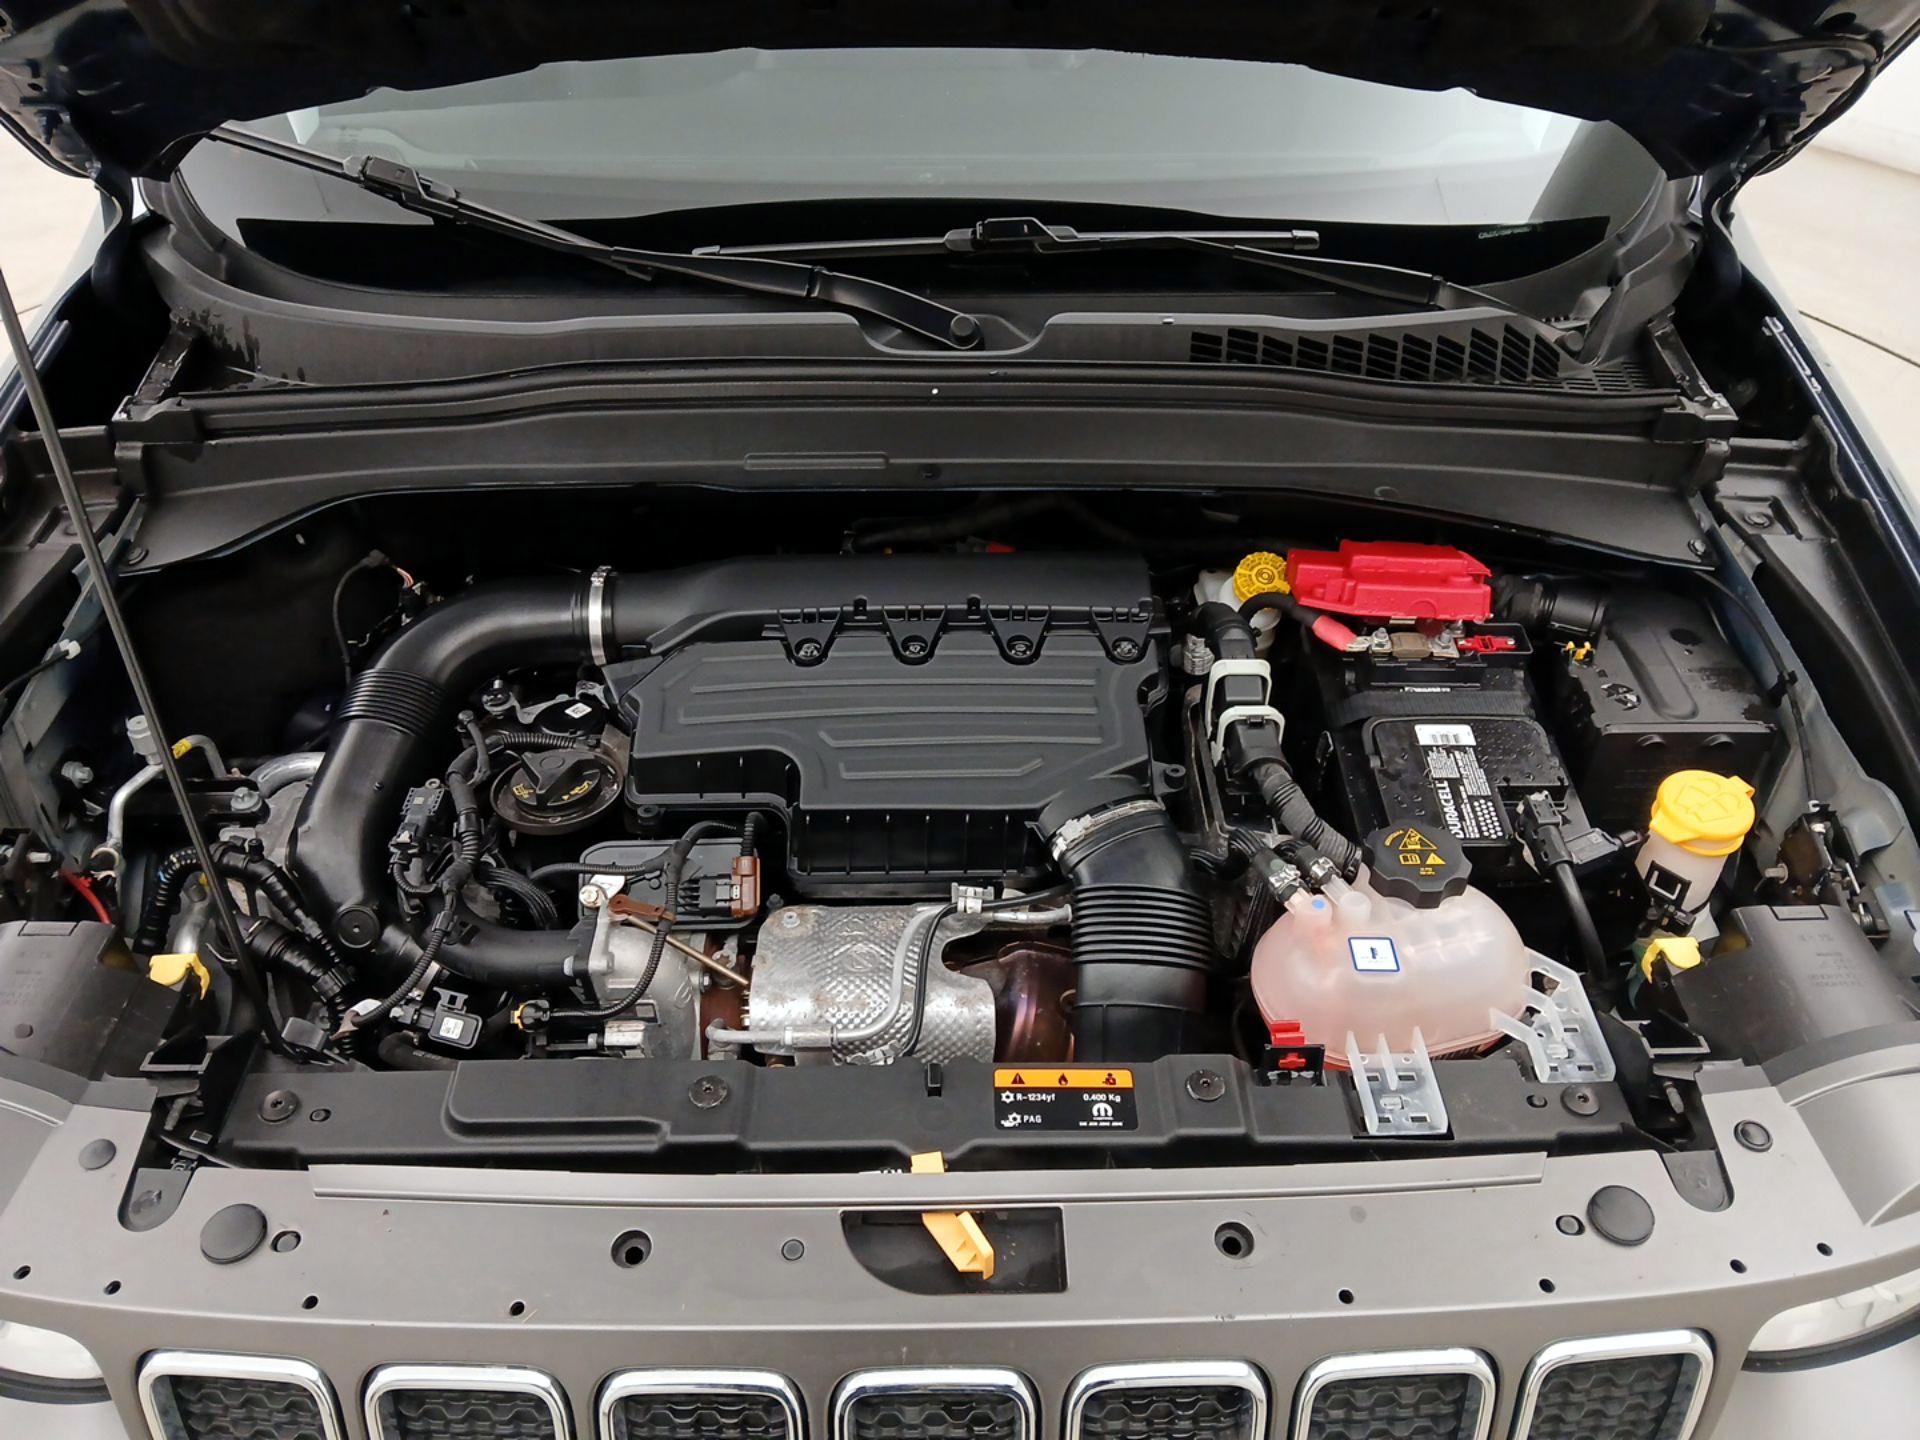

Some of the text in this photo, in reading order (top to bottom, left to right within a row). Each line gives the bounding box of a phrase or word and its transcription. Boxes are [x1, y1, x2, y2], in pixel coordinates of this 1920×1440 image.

[1434, 780, 1465, 838] DURACELL
[1016, 1092, 1056, 1103] R-1234yf
[1082, 1093, 1121, 1103] 0.400 Kg
[1023, 1114, 1042, 1124] PAG
